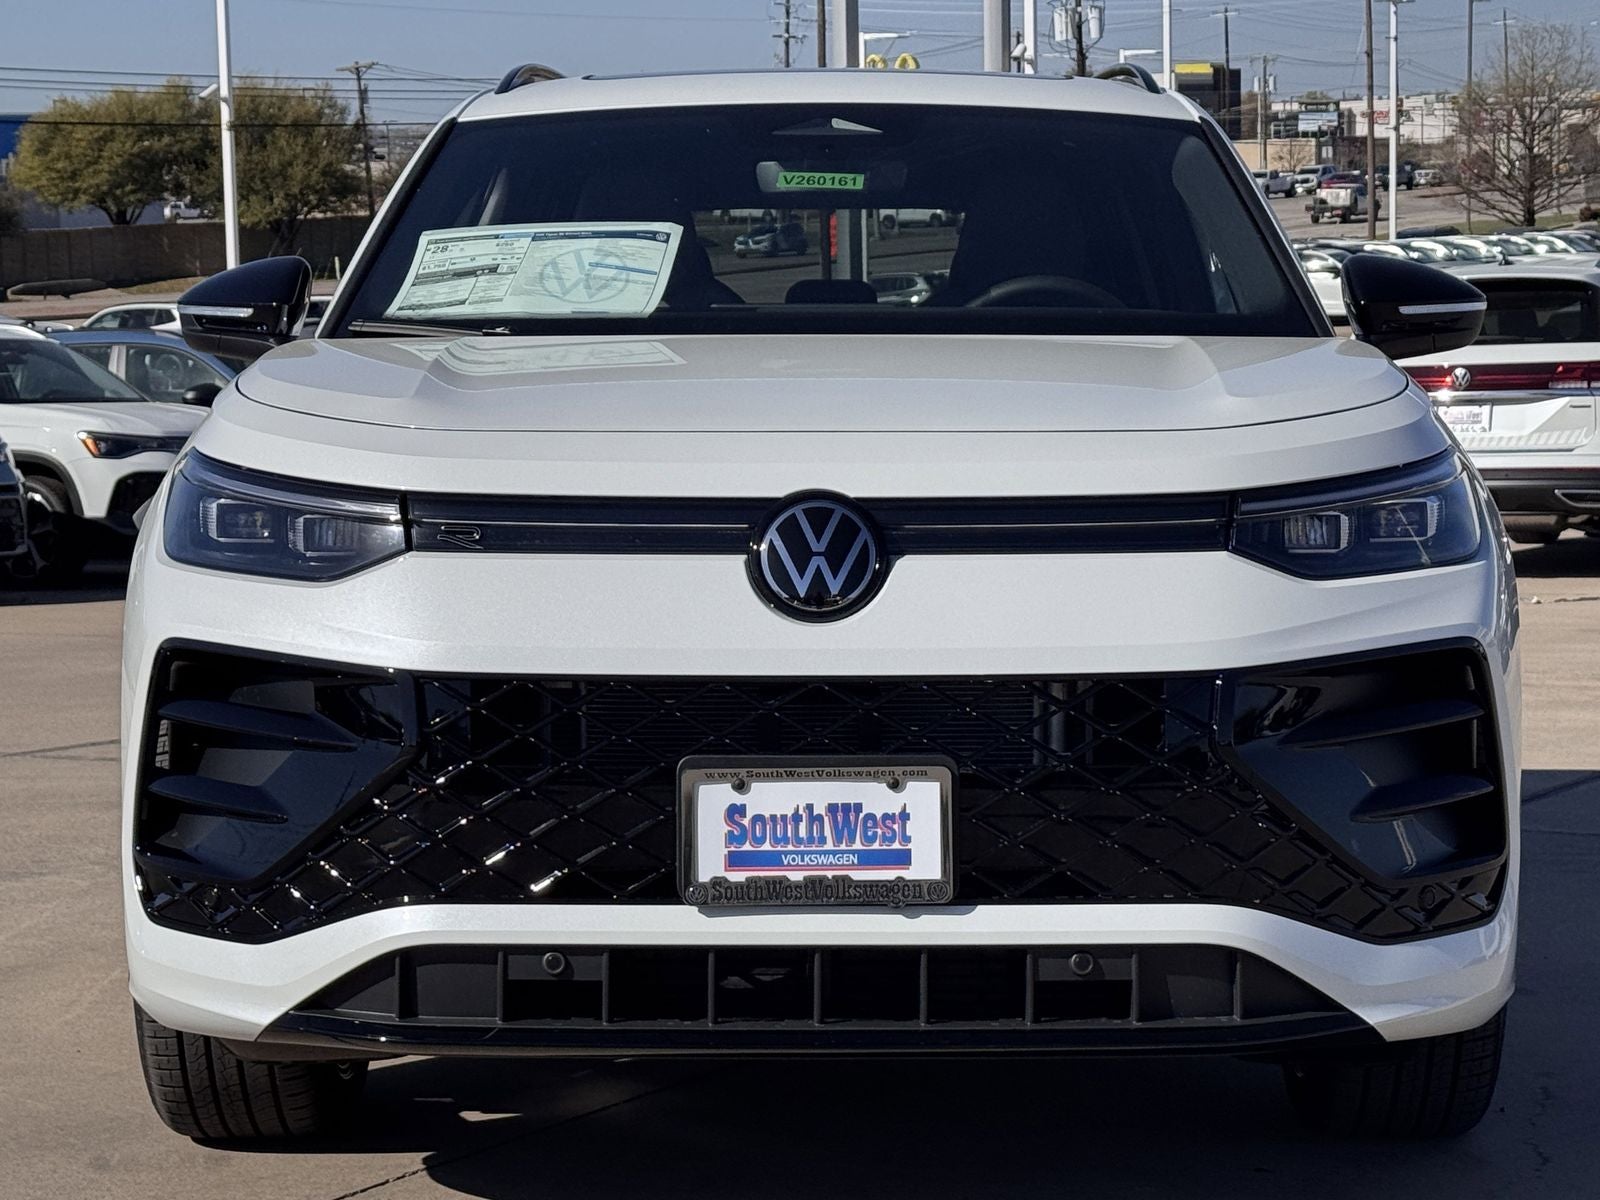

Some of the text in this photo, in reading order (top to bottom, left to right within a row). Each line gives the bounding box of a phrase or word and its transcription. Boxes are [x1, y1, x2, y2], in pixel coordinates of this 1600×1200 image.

[783, 175, 858, 186] V260161
[431, 245, 449, 254] 28
[760, 500, 876, 611] VW
[704, 769, 929, 780] www.SouthWestVolkswagen.com
[724, 802, 912, 848] SouthWest
[781, 853, 858, 865] VOLKSWAGEN
[711, 878, 924, 906] SouthWestVolkswagen
